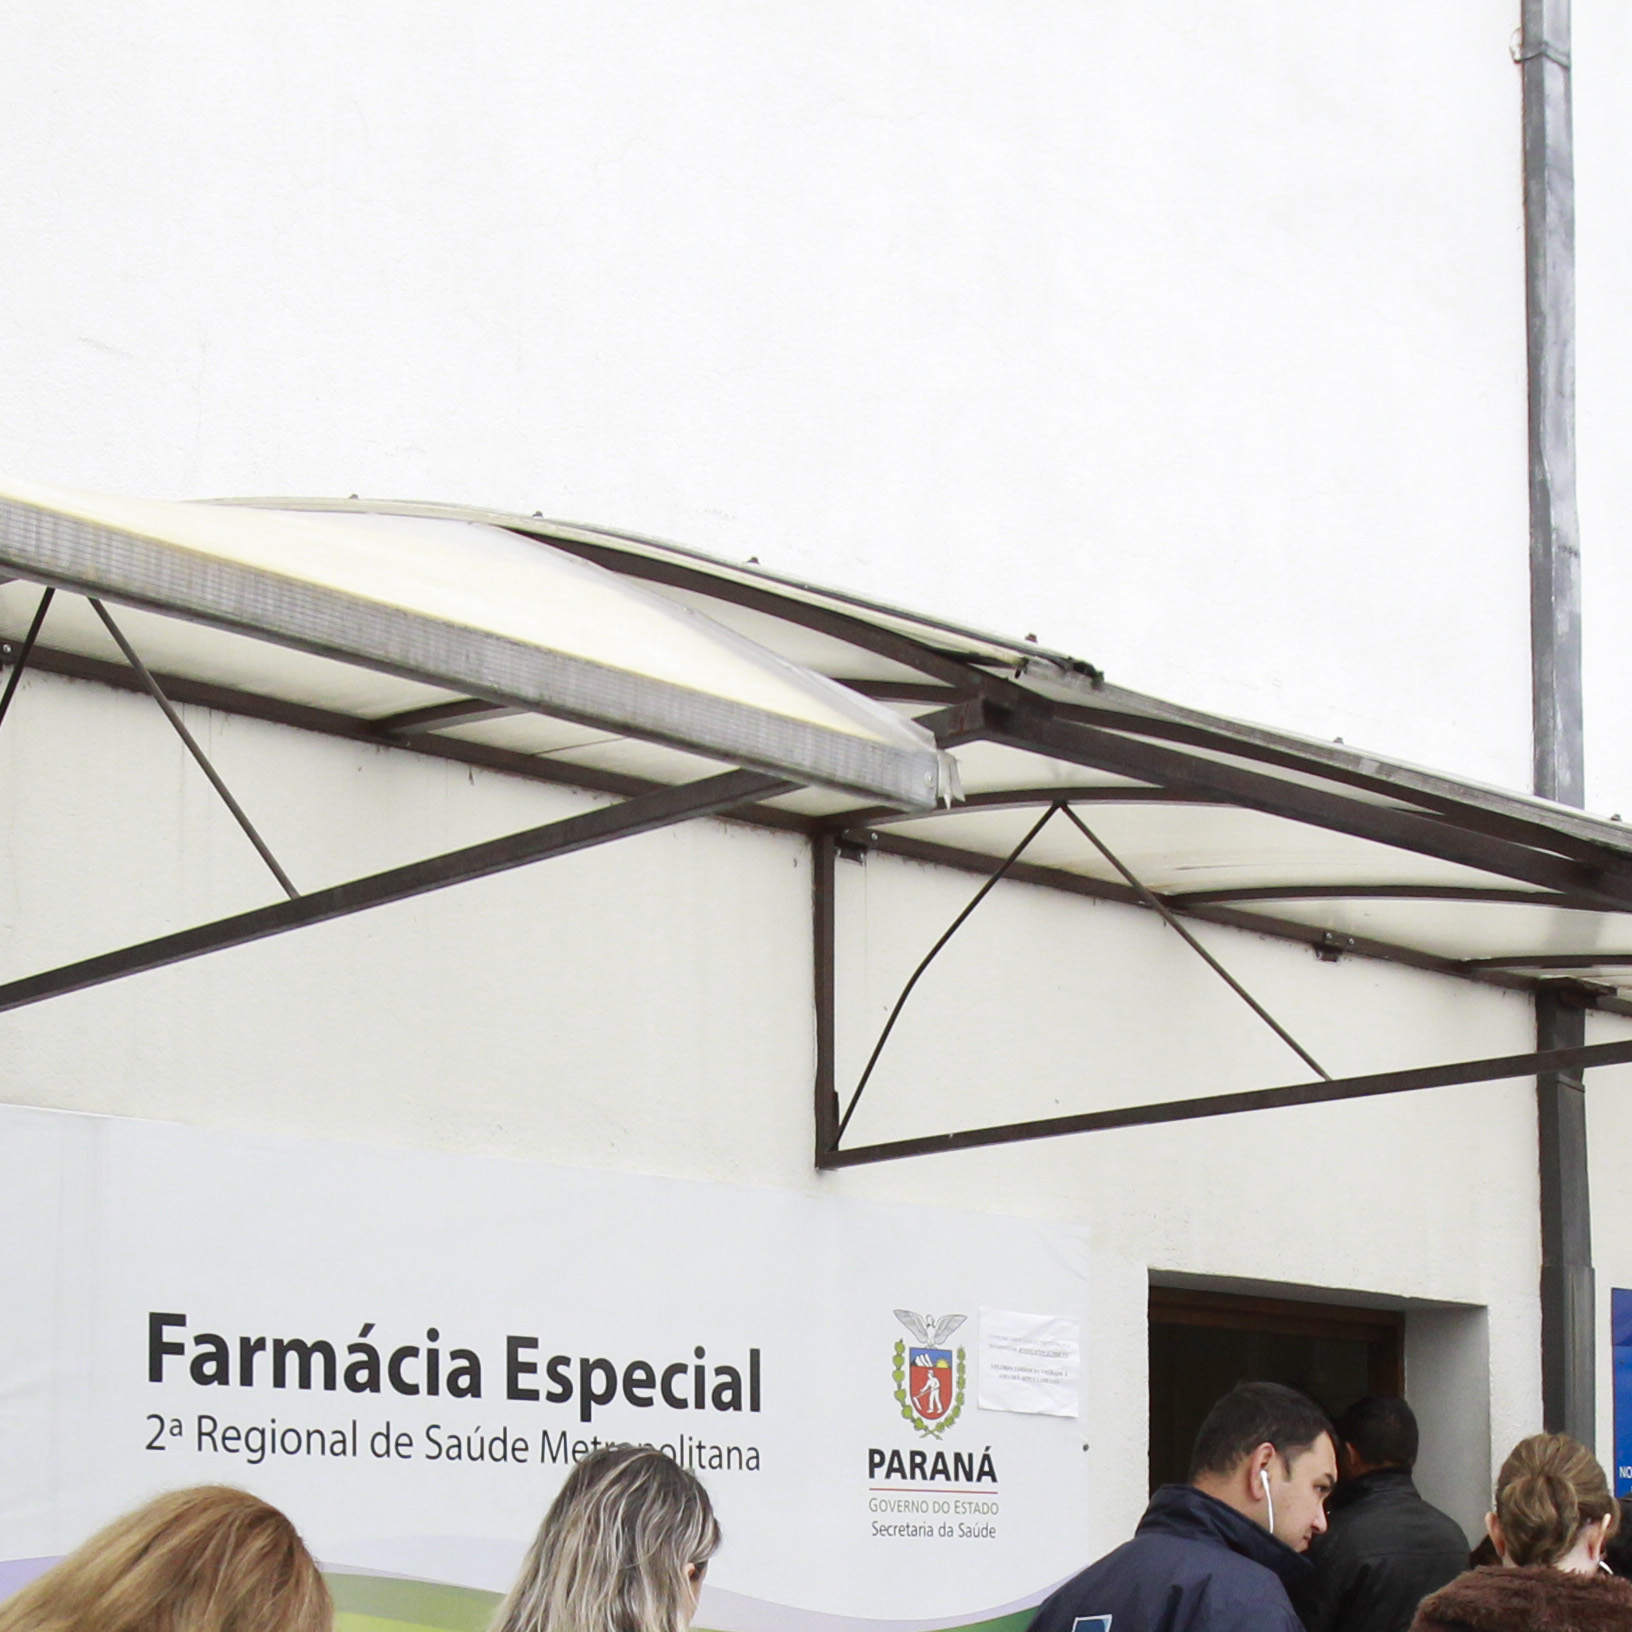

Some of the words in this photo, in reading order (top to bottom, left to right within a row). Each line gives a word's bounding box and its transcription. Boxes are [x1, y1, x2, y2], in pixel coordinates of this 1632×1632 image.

[148, 1311, 482, 1398] Farmácia
[506, 1335, 761, 1422] Especial
[145, 1413, 183, 1452] 2ª
[196, 1414, 357, 1465] Regional
[369, 1420, 414, 1460] de
[424, 1424, 529, 1462] Saúde
[540, 1429, 761, 1471] Metolitana
[868, 1445, 999, 1483] PARANÁ
[868, 1497, 929, 1515] GOVERNO
[932, 1501, 951, 1515] DO
[954, 1499, 1000, 1516] ESTADO
[871, 1520, 934, 1538] Secretaria
[937, 1521, 954, 1538] da
[958, 1521, 997, 1539] Saúde
